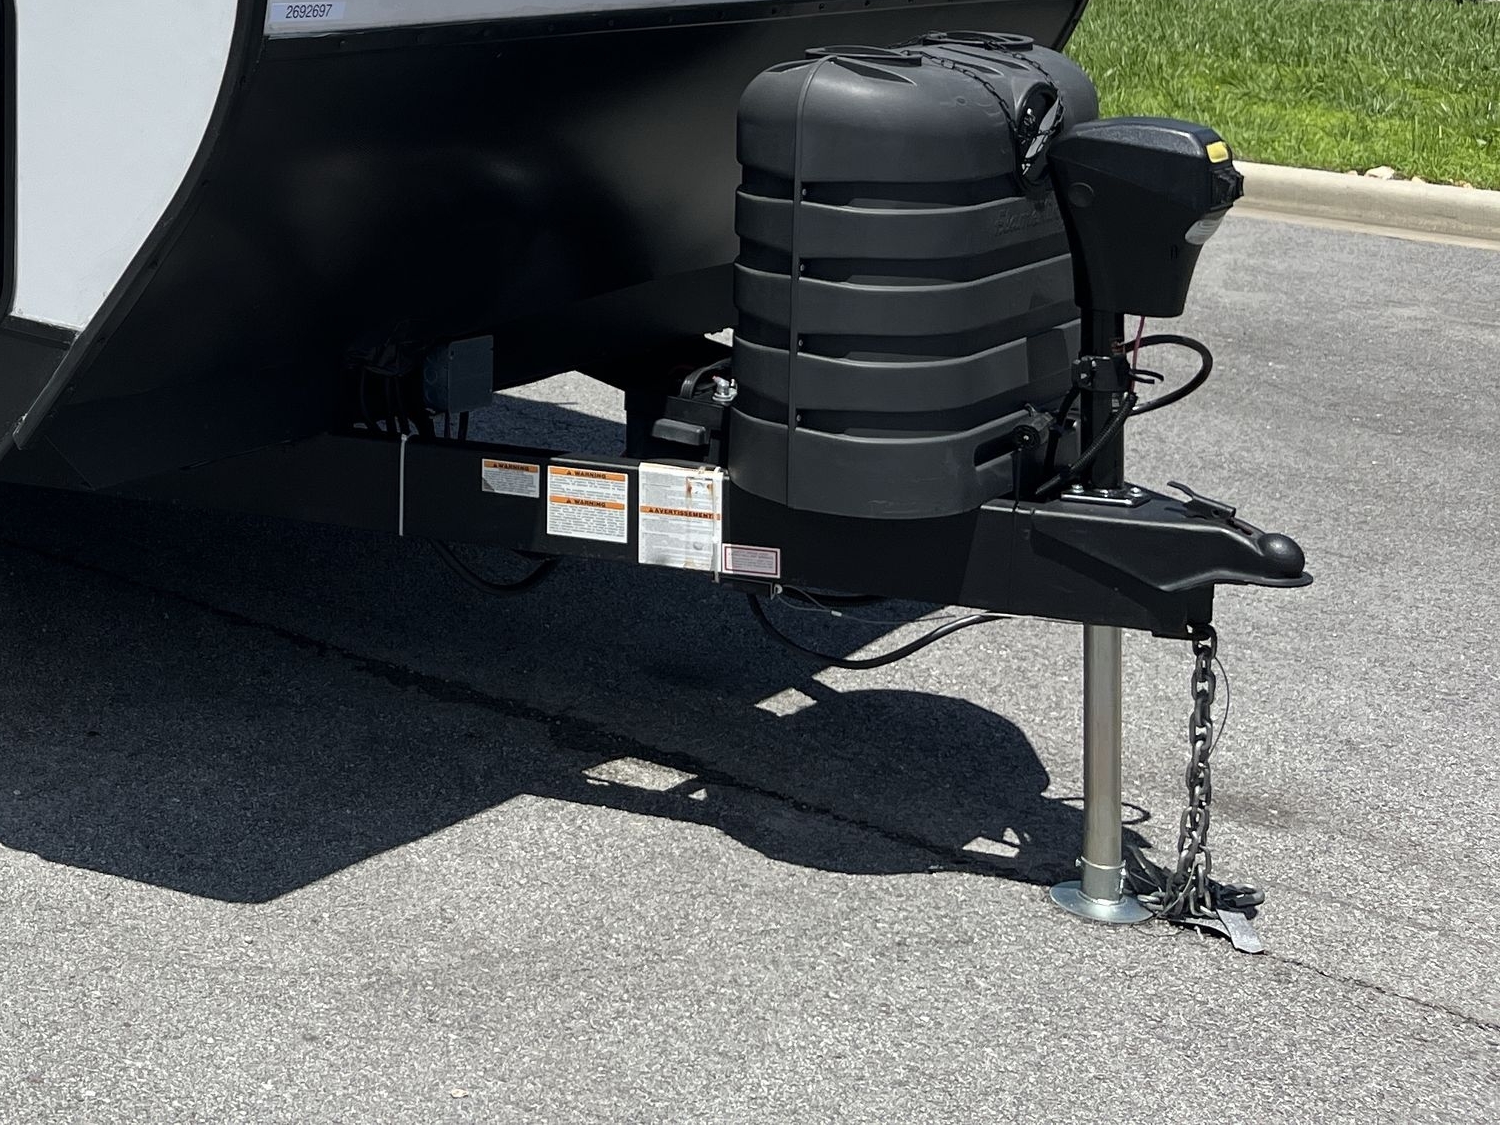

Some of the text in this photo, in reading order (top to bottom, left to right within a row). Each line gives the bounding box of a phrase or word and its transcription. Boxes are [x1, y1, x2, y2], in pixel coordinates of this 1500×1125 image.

[285, 3, 333, 19] 2692697
[498, 463, 530, 472] WARNING
[574, 470, 607, 479] WARNING
[573, 499, 606, 508] WARNING
[654, 506, 713, 519] AVERTISSEMENT
